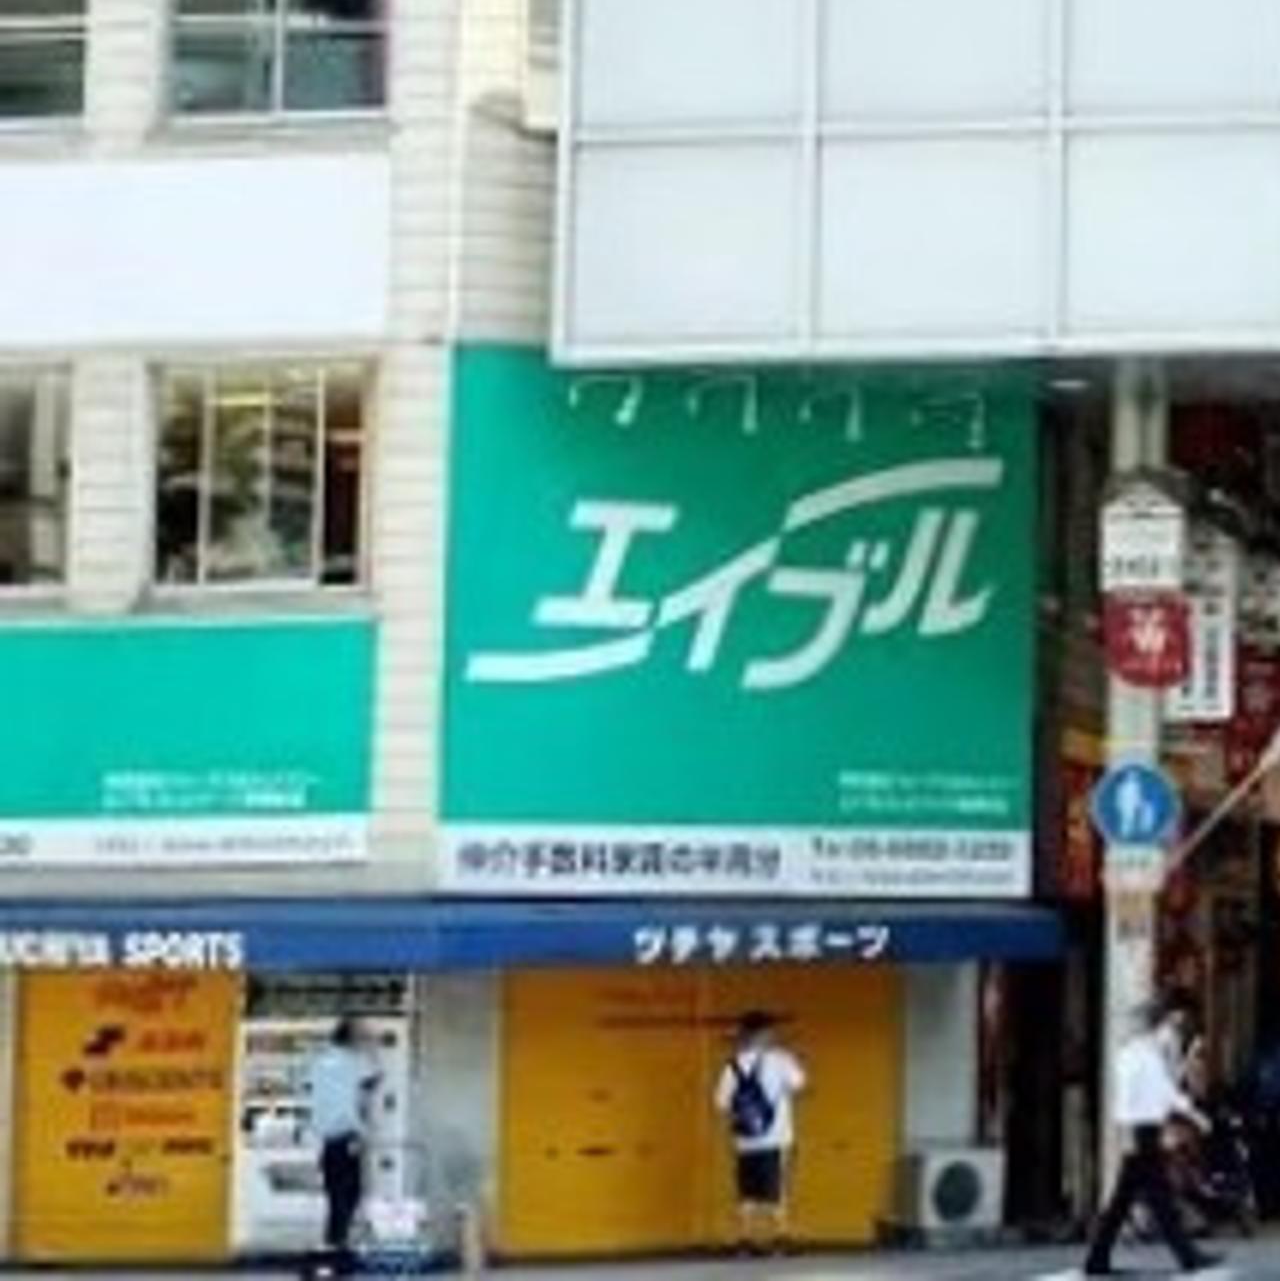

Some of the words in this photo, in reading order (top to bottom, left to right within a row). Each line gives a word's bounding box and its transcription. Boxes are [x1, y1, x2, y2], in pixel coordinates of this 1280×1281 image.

[466, 458, 1003, 689] エイブル
[122, 930, 246, 970] SPORTS
